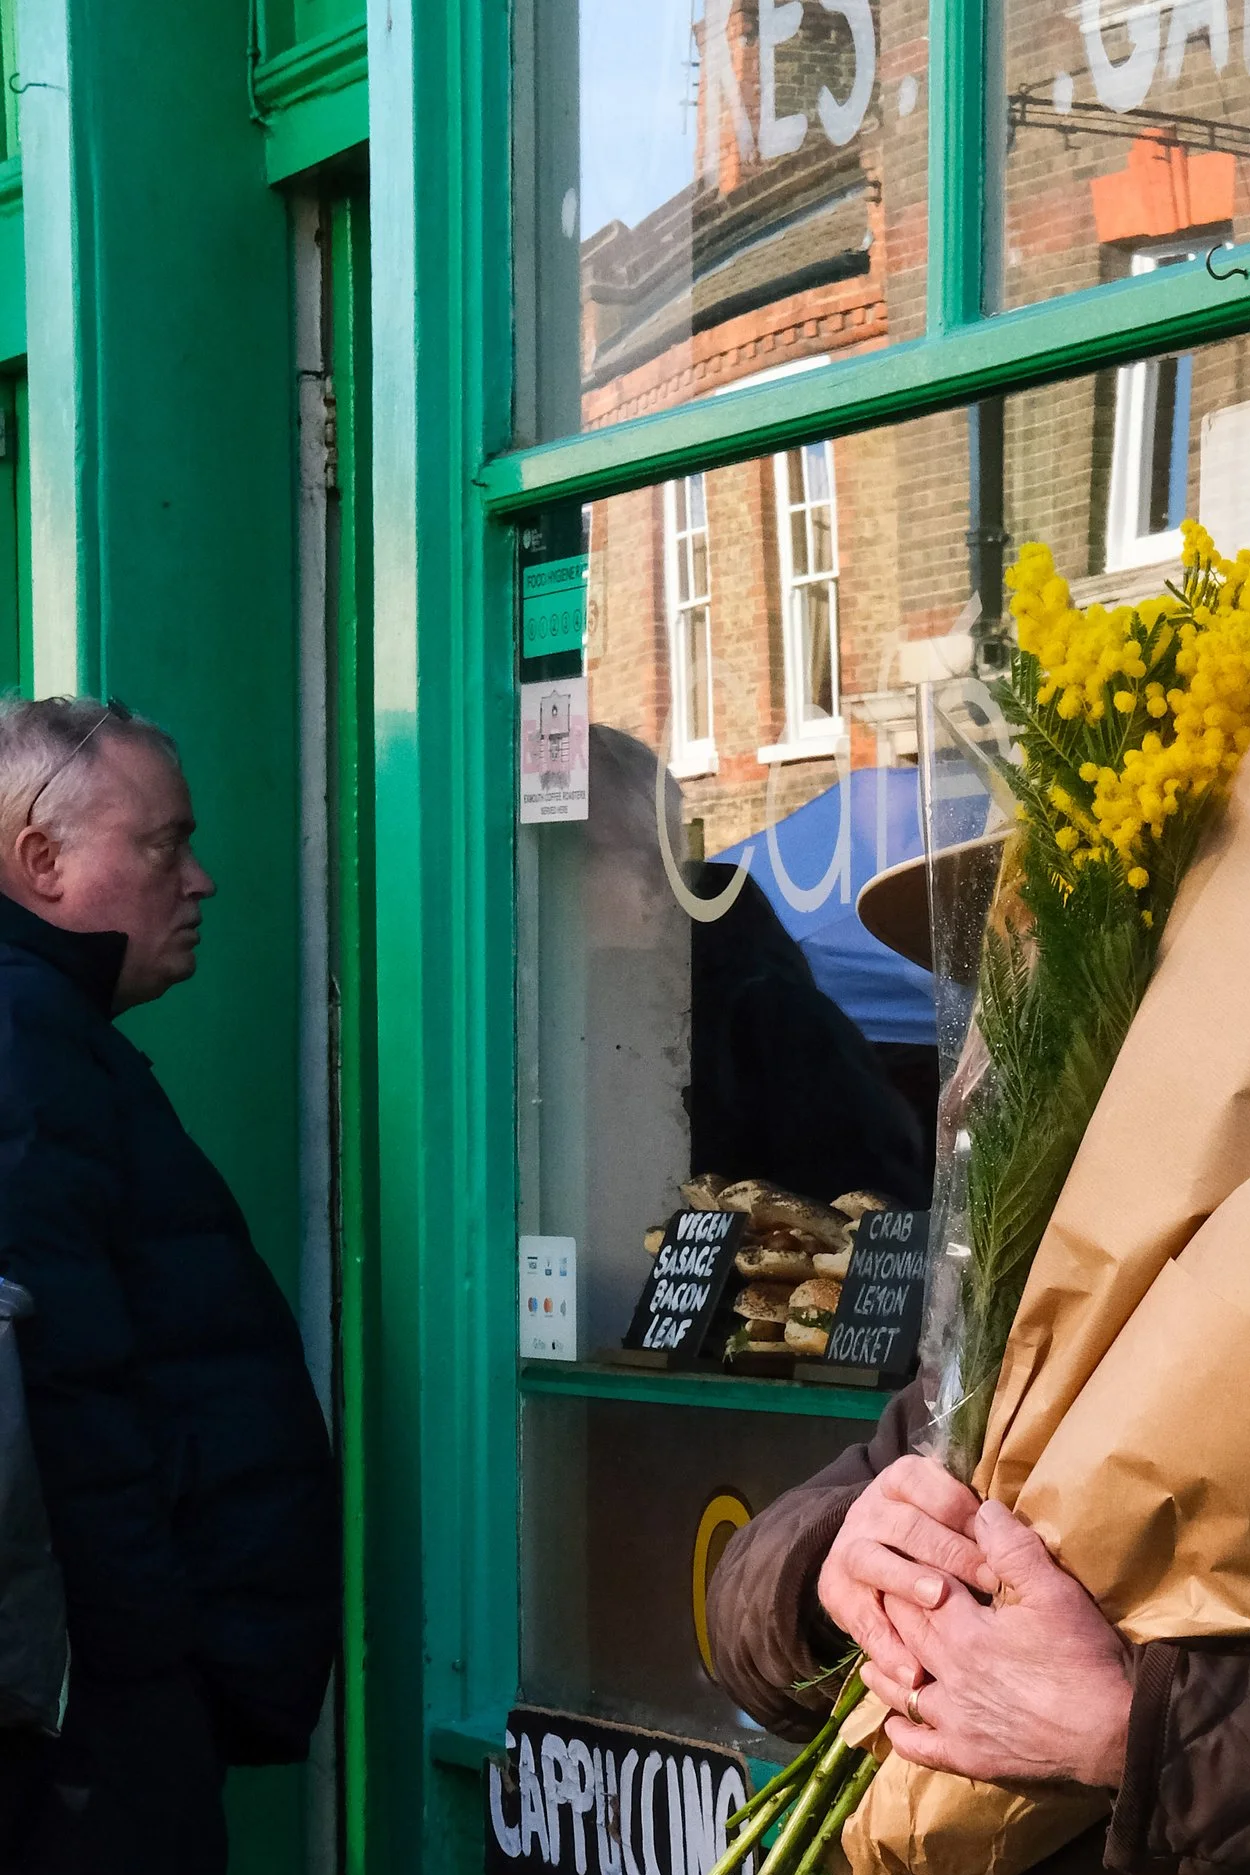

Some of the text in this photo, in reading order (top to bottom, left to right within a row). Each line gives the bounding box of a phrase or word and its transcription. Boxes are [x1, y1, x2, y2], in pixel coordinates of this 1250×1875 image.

[869, 1212, 914, 1242] CRAB
[653, 1245, 721, 1279] SASAGE
[649, 1279, 711, 1314] BACON
[854, 1284, 910, 1316] LEMON
[642, 1313, 693, 1349] LEAF
[827, 1323, 901, 1364] ROCKET
